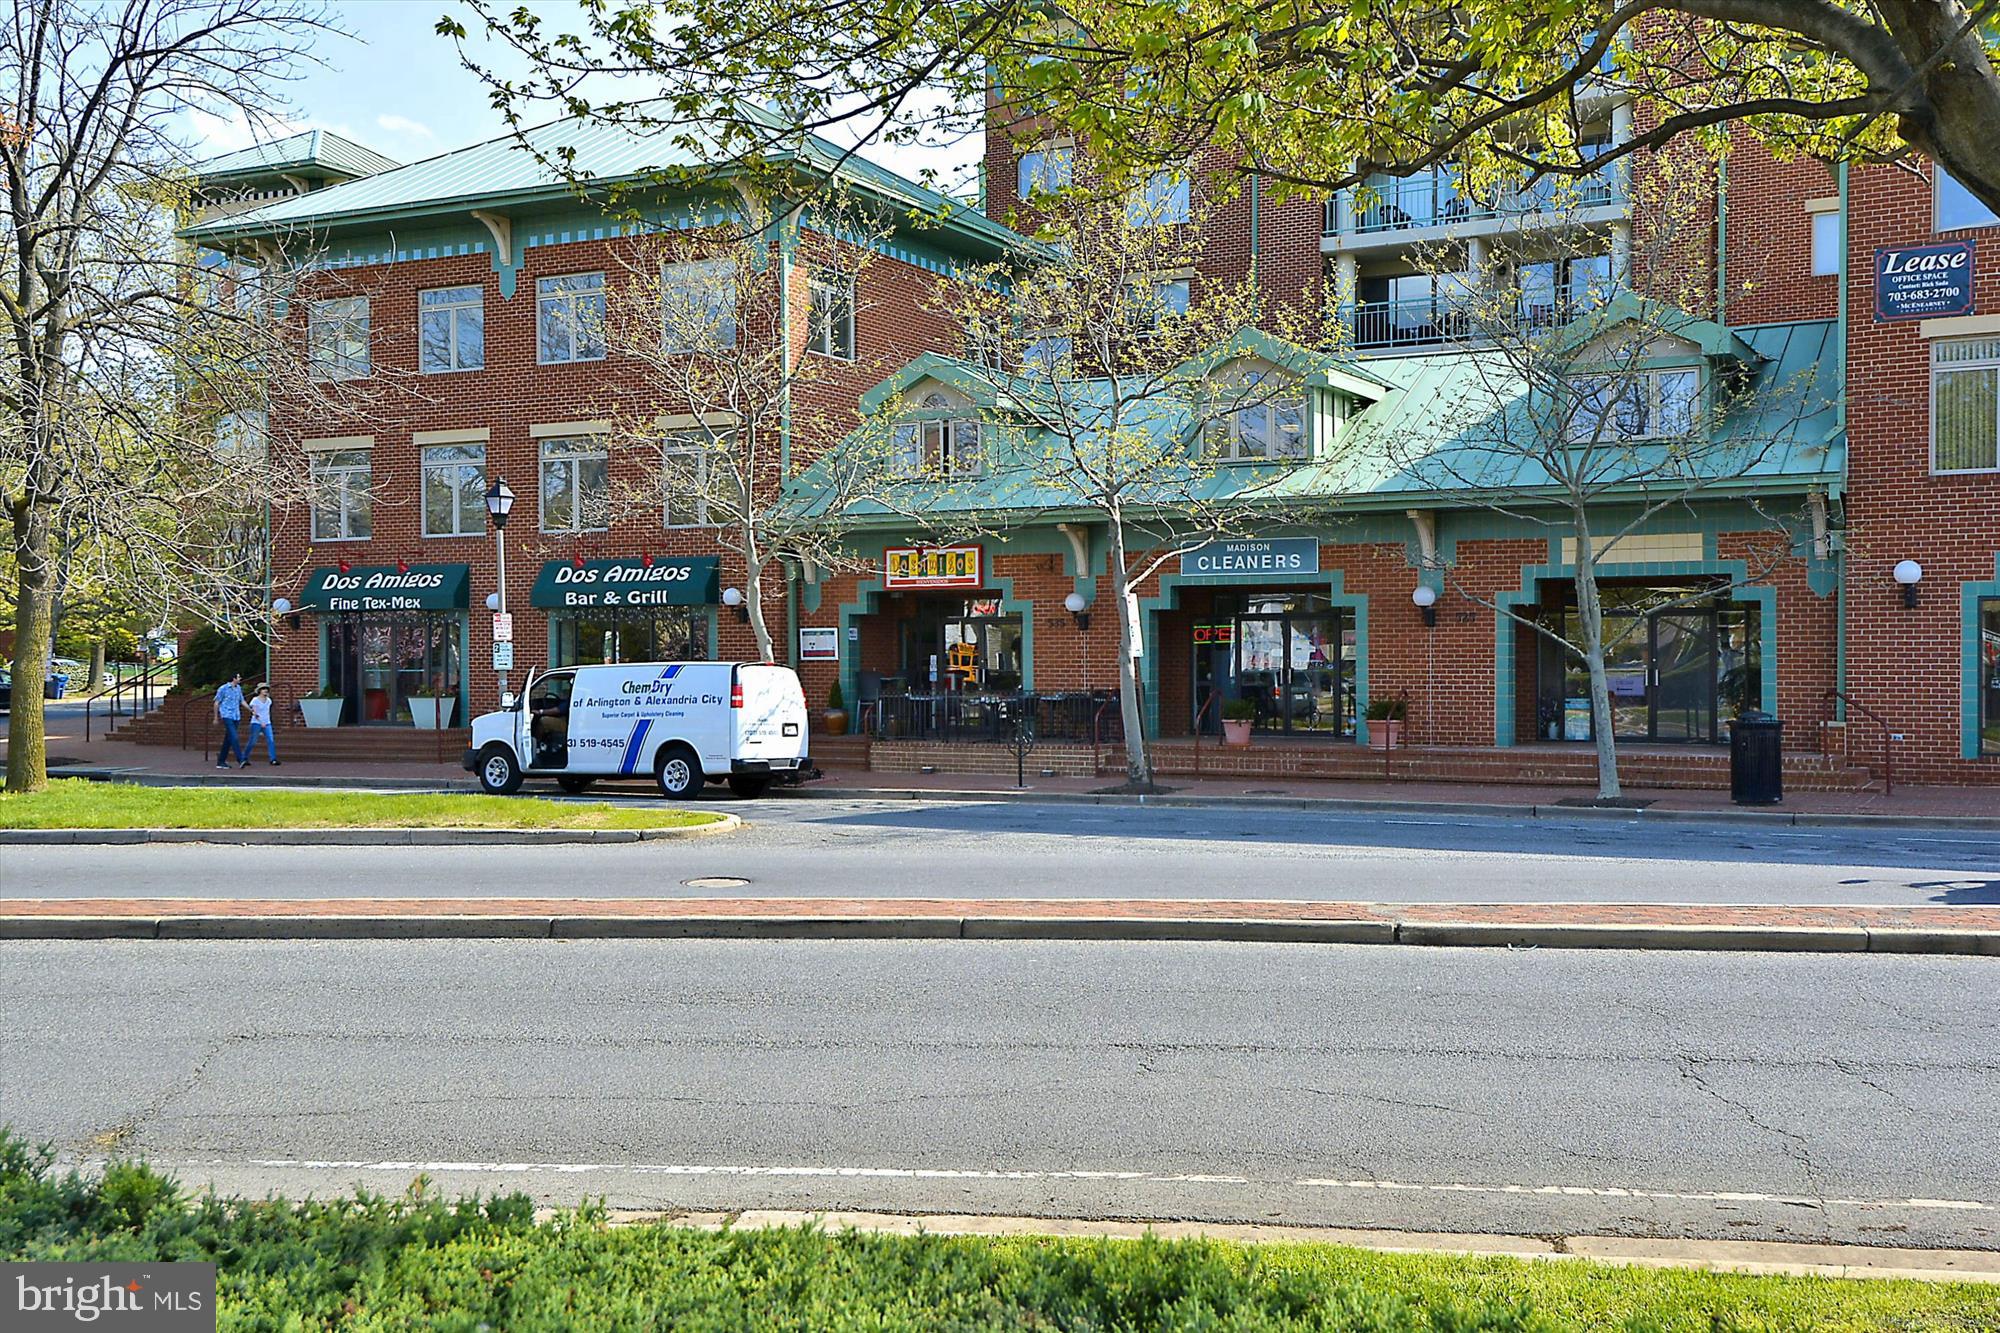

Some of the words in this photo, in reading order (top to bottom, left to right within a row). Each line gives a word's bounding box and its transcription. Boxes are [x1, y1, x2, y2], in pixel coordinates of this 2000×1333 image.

[1882, 252, 1967, 274] Lease
[1892, 274, 1921, 282] OFFICE
[1923, 272, 1948, 280] SPACE
[1227, 543, 1270, 552] MADISON
[1197, 553, 1301, 571] CLEANERS
[321, 574, 362, 590] Dos
[364, 571, 444, 589] Amigos
[554, 566, 599, 584] Dos
[603, 564, 692, 583] Amigos
[330, 597, 359, 610] Fine
[362, 596, 421, 609] Tex-Mex
[565, 592, 598, 606] Bar
[603, 591, 621, 605] &
[627, 590, 668, 604] Grill
[1194, 628, 1234, 641] OPE
[622, 680, 673, 697] ChemDry
[573, 700, 583, 708] of
[586, 697, 631, 708] Arlington
[634, 695, 641, 706] &
[645, 694, 698, 706] Alexandria
[701, 694, 723, 706] City
[580, 738, 625, 748] 519-4545
